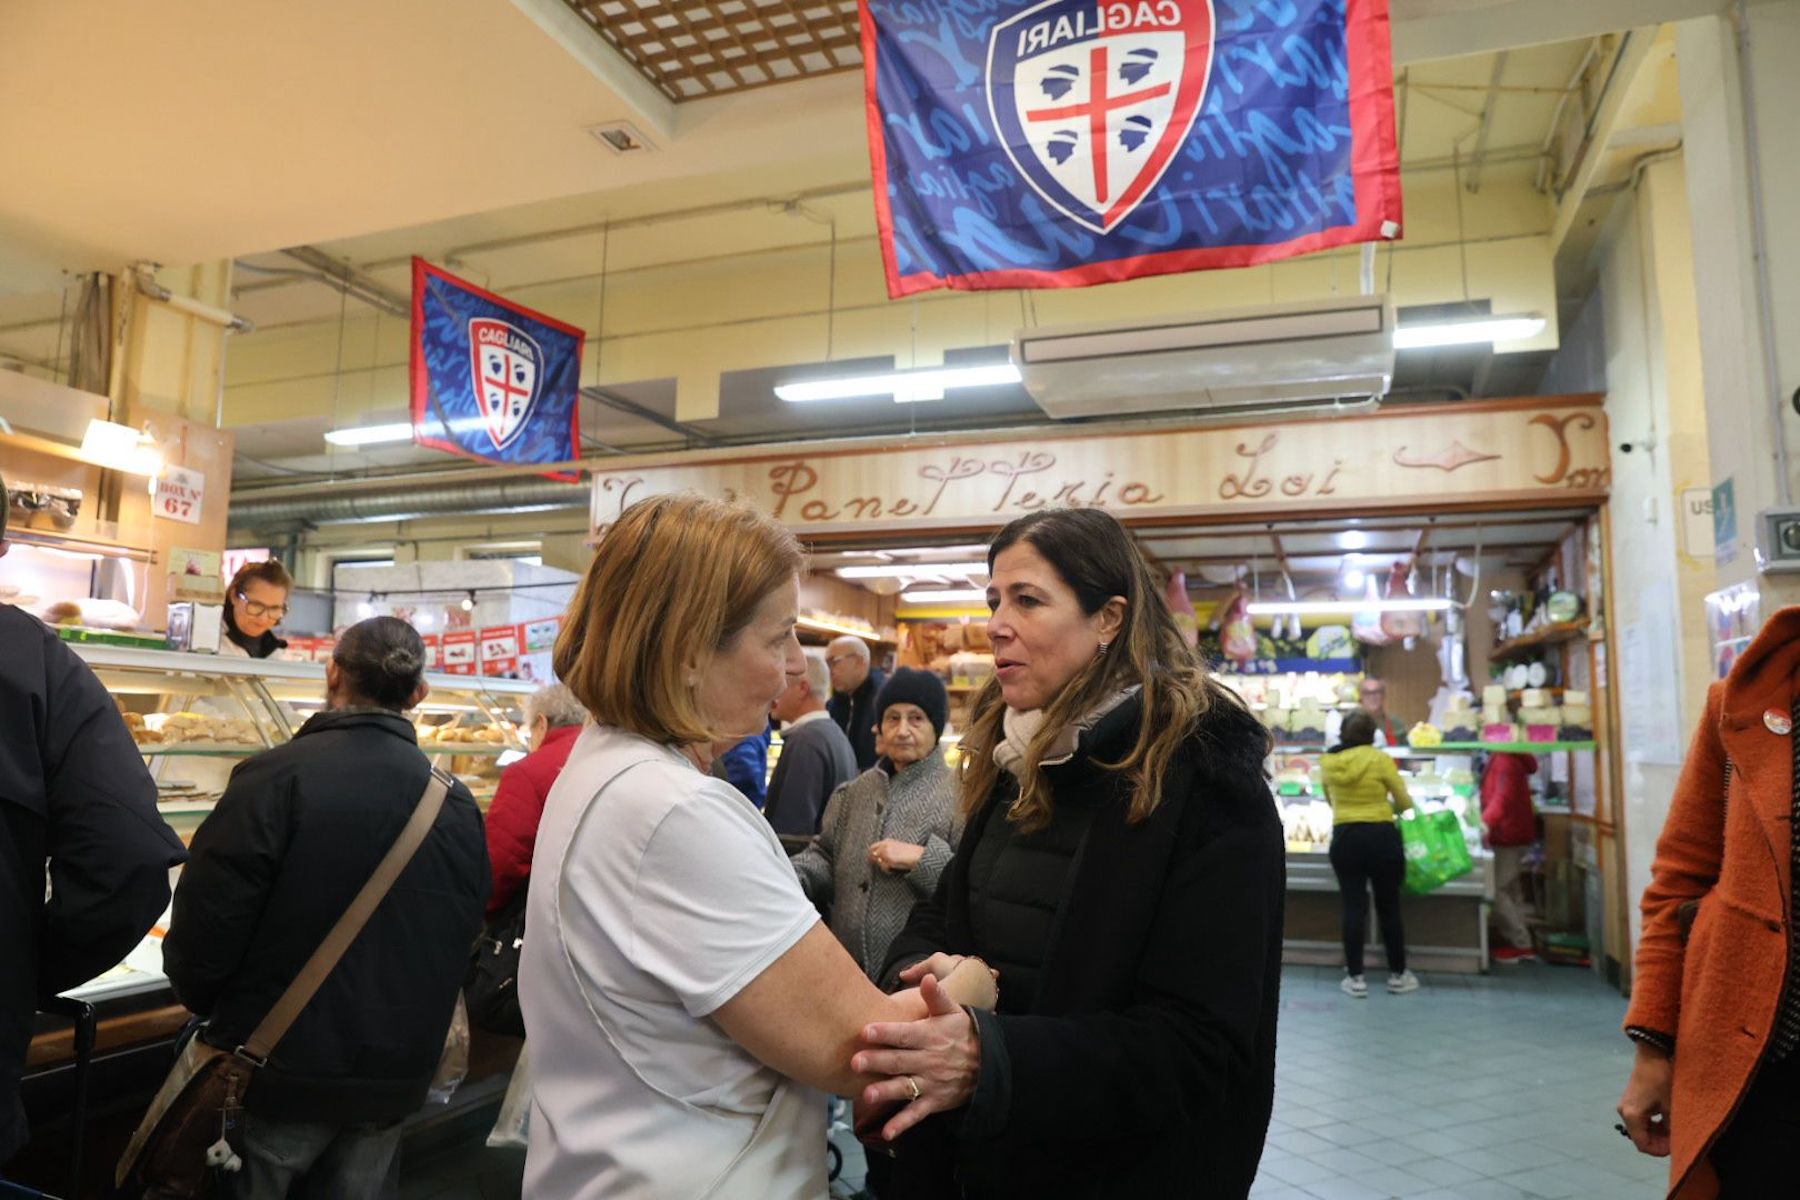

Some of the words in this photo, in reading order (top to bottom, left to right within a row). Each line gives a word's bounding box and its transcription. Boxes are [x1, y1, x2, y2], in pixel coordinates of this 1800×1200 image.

[478, 327, 535, 361] CAGLIARI
[160, 481, 186, 498] BOX
[164, 498, 192, 517] 67
